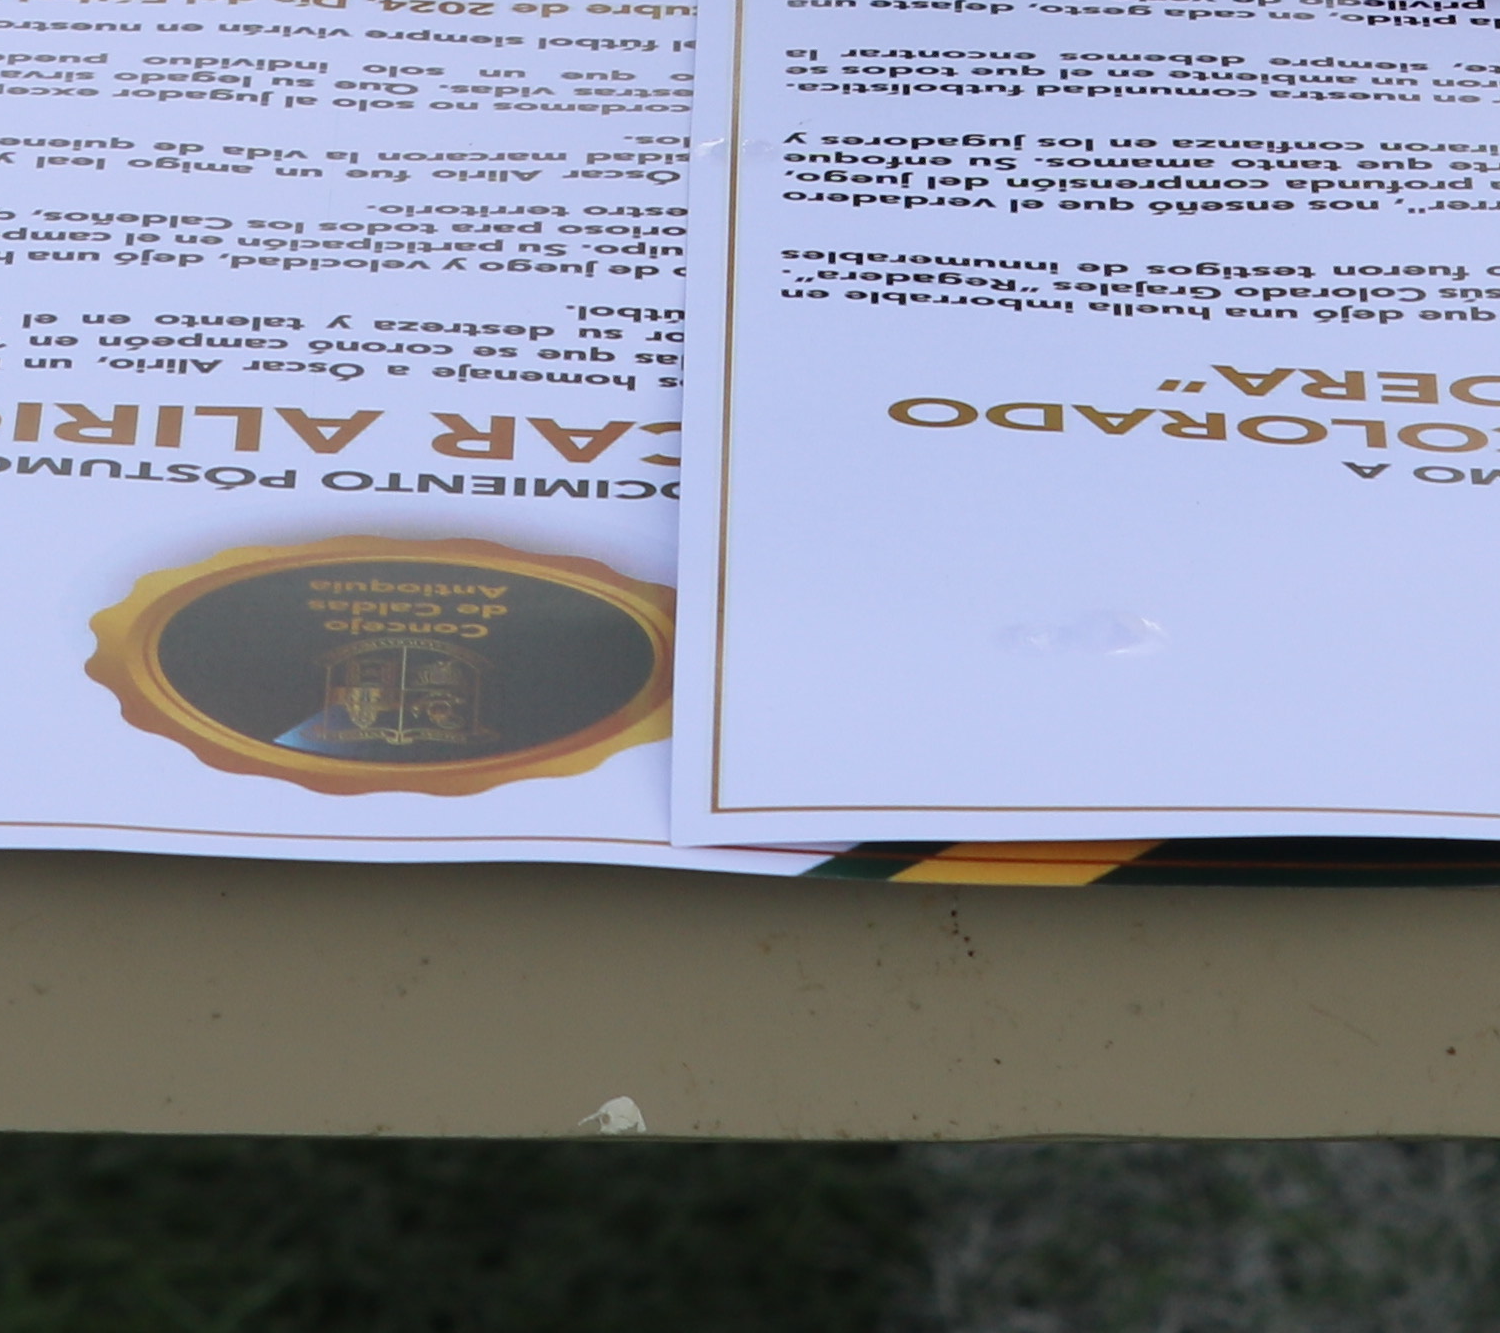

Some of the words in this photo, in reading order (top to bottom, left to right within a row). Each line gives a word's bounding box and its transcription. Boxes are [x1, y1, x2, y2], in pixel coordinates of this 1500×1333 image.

[509, 3, 570, 18] de
[781, 288, 830, 299] en
[844, 290, 1074, 314] imborrable
[1088, 302, 1211, 322] huella
[1225, 307, 1298, 319] una
[1312, 305, 1404, 325] dejó
[1418, 306, 1497, 322] que
[24, 358, 73, 369] un
[96, 356, 223, 375] Alirio,
[242, 360, 365, 382] Óscar
[387, 365, 410, 376] a
[431, 363, 636, 392] homenaje
[1341, 461, 1392, 479] A
